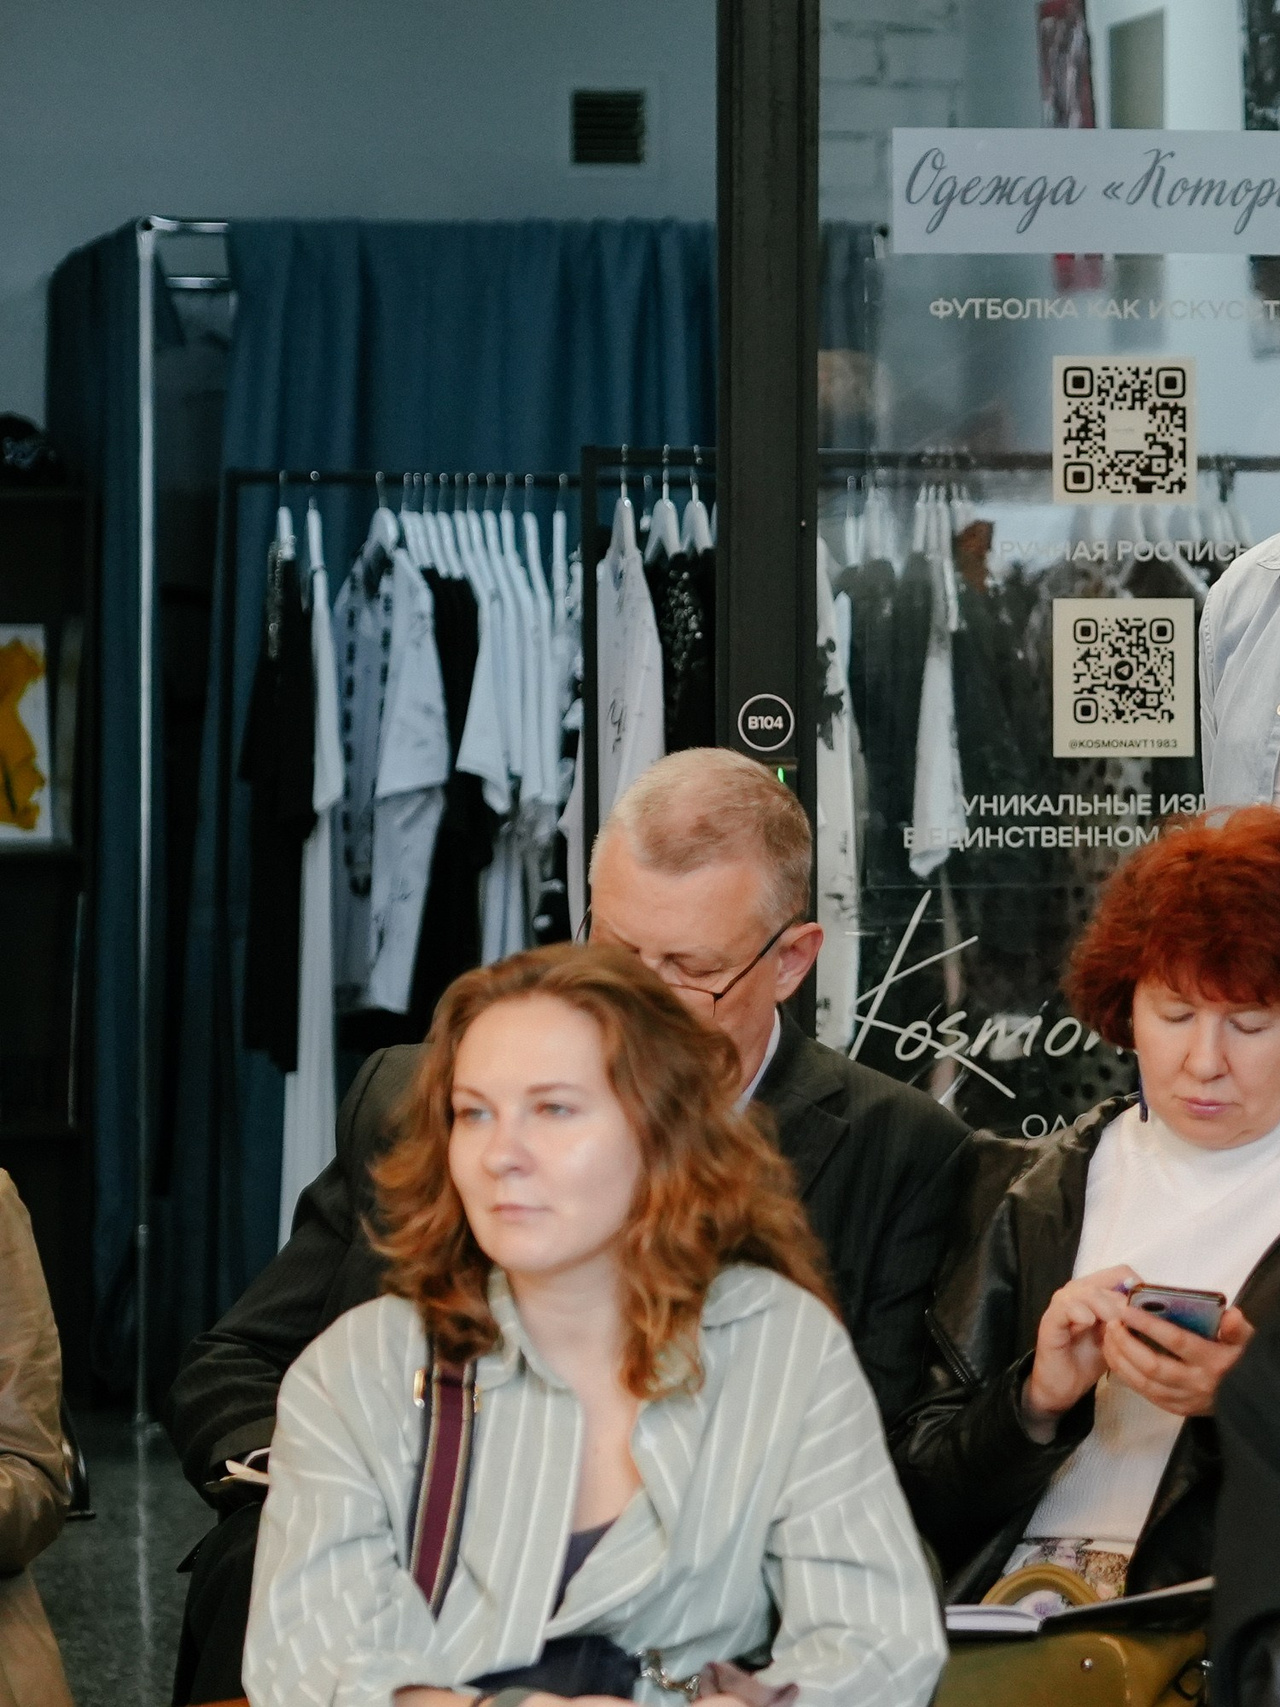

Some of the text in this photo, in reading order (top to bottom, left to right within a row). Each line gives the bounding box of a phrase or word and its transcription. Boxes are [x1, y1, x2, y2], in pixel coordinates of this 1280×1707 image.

[905, 147, 1086, 234] Одежда
[929, 297, 1078, 320] ФУТБОЛКА
[1087, 298, 1140, 319] КАК
[748, 715, 784, 730] B104
[1069, 738, 1178, 750] @KOSMONAVT1983
[961, 794, 1152, 817] УНИКАЛЬНЫЕ
